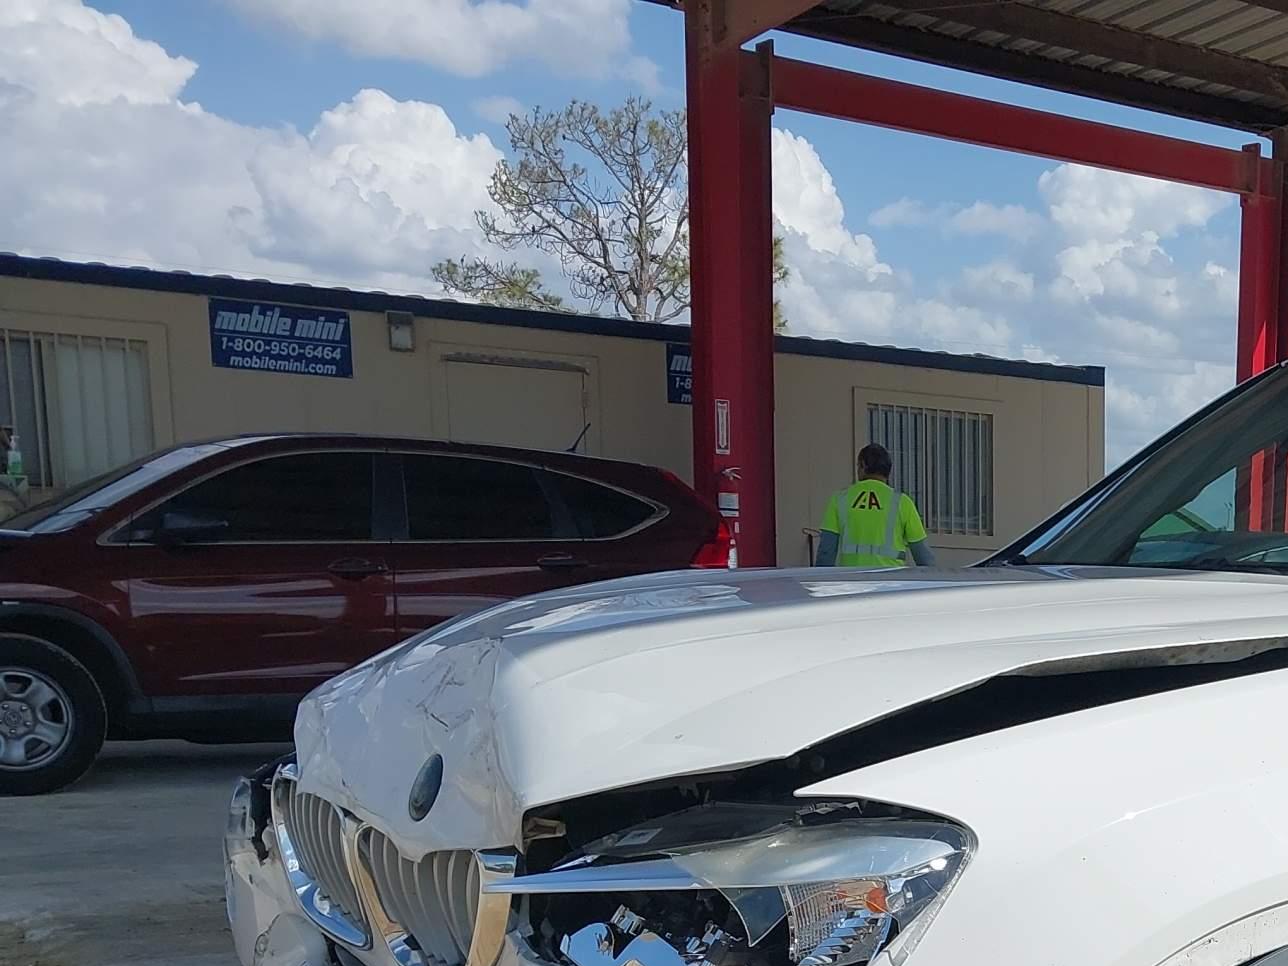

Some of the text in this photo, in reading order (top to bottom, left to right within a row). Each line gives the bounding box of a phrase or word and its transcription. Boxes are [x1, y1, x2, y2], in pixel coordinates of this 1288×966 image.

[214, 305, 345, 340] mobile mini
[221, 337, 341, 360] 1-800-950-6464
[229, 355, 337, 375] mobilemini.com
